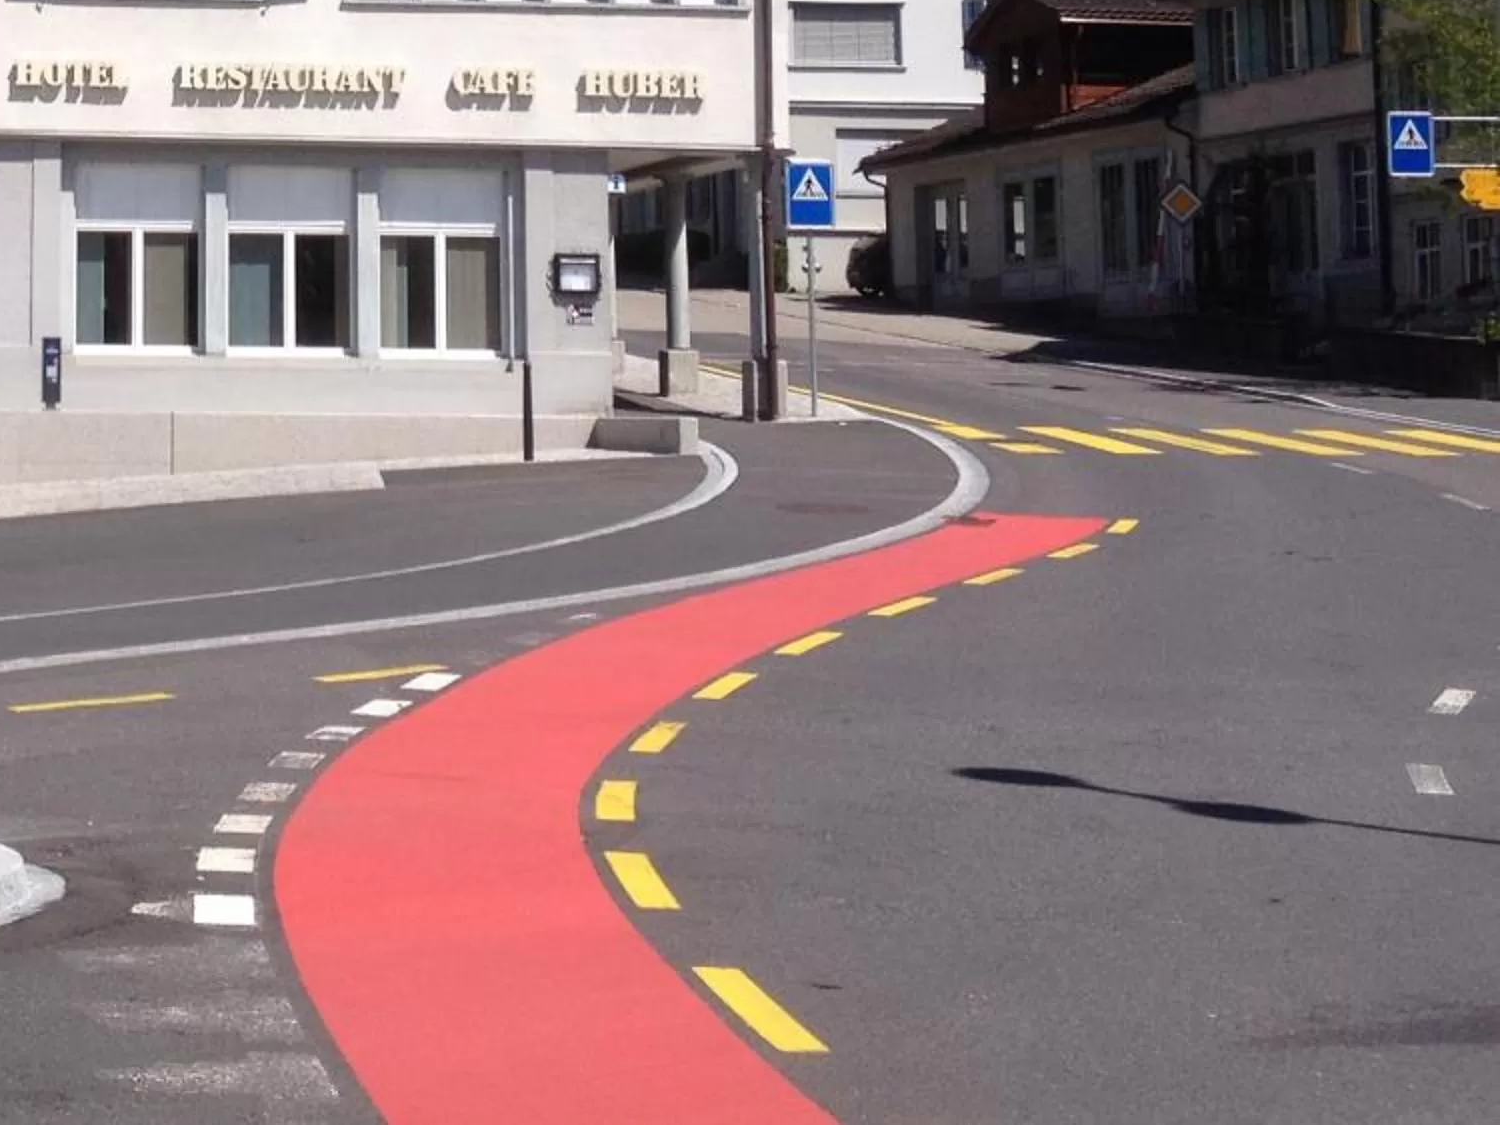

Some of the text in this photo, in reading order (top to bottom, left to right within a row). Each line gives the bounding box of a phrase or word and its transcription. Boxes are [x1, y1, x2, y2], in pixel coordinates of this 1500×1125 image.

[13, 61, 705, 99] HOTEL RESTAURANT CAFE HUBER
